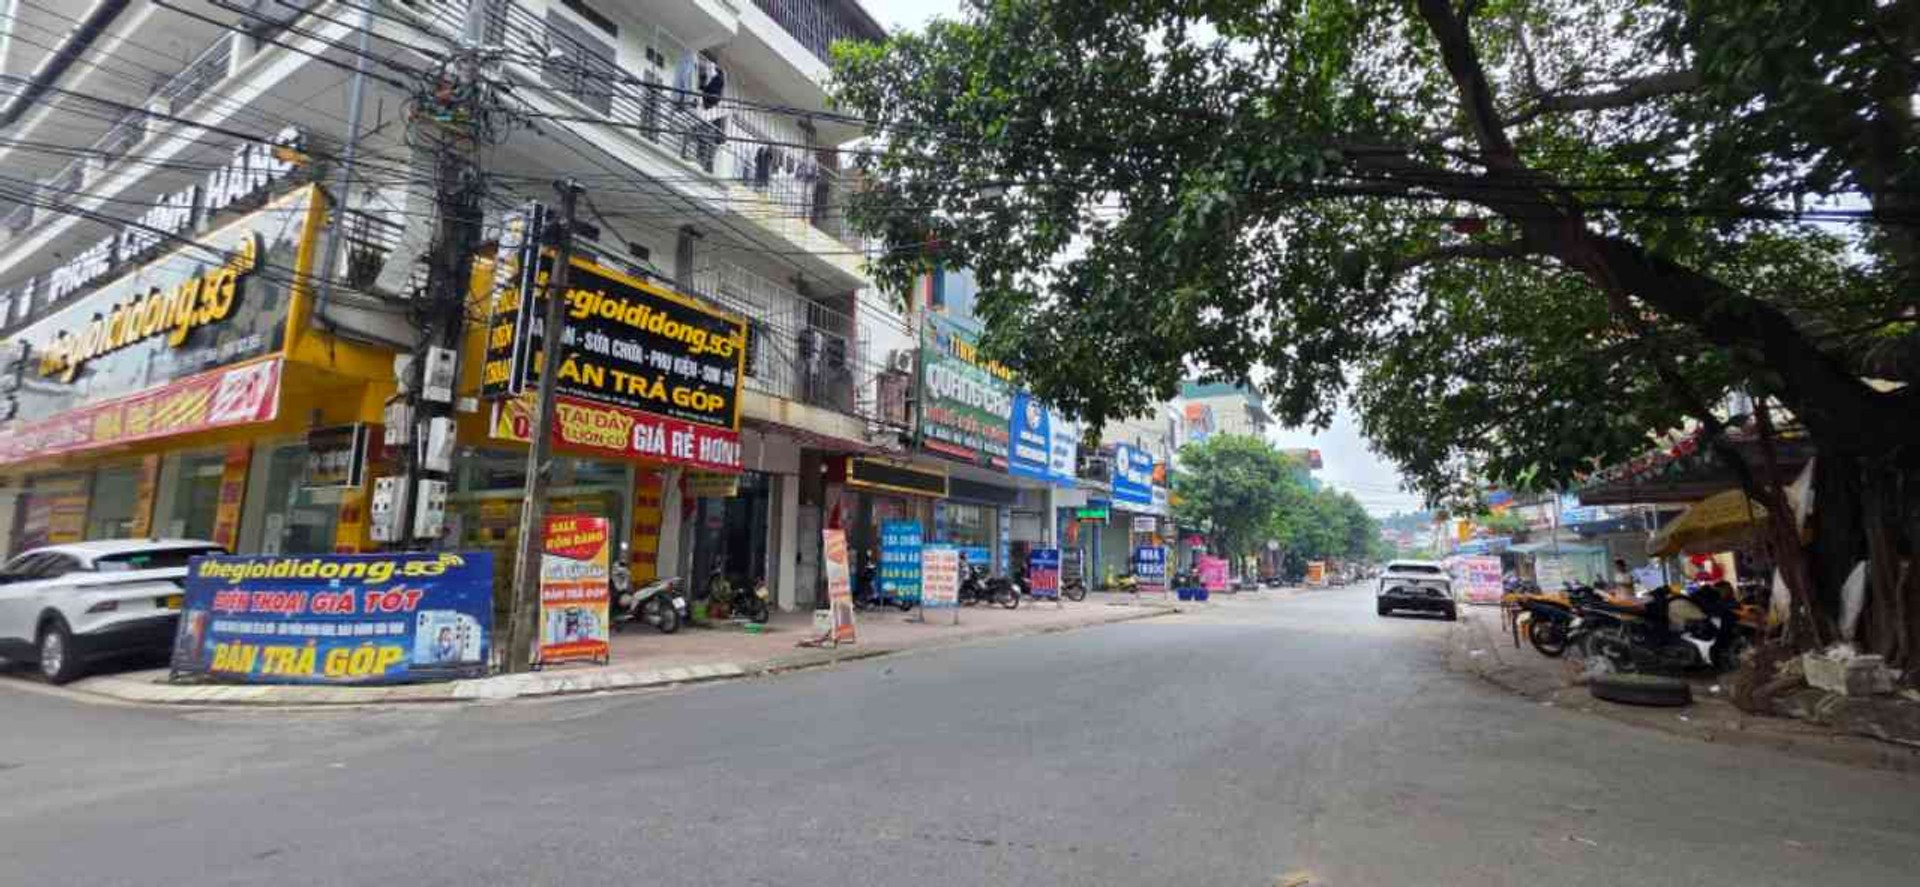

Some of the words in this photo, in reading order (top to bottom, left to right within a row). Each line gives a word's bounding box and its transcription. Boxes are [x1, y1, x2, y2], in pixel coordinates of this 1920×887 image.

[610, 369, 667, 401] TRẢ
[672, 382, 724, 413] GÓP
[633, 422, 665, 455] GIÁ
[671, 425, 696, 459] RẺ
[700, 436, 741, 467] HƠN!
[311, 588, 355, 614] GIÁ
[364, 584, 424, 613] TỐT
[261, 639, 317, 675] TRẢ
[323, 641, 404, 678] GÓP
